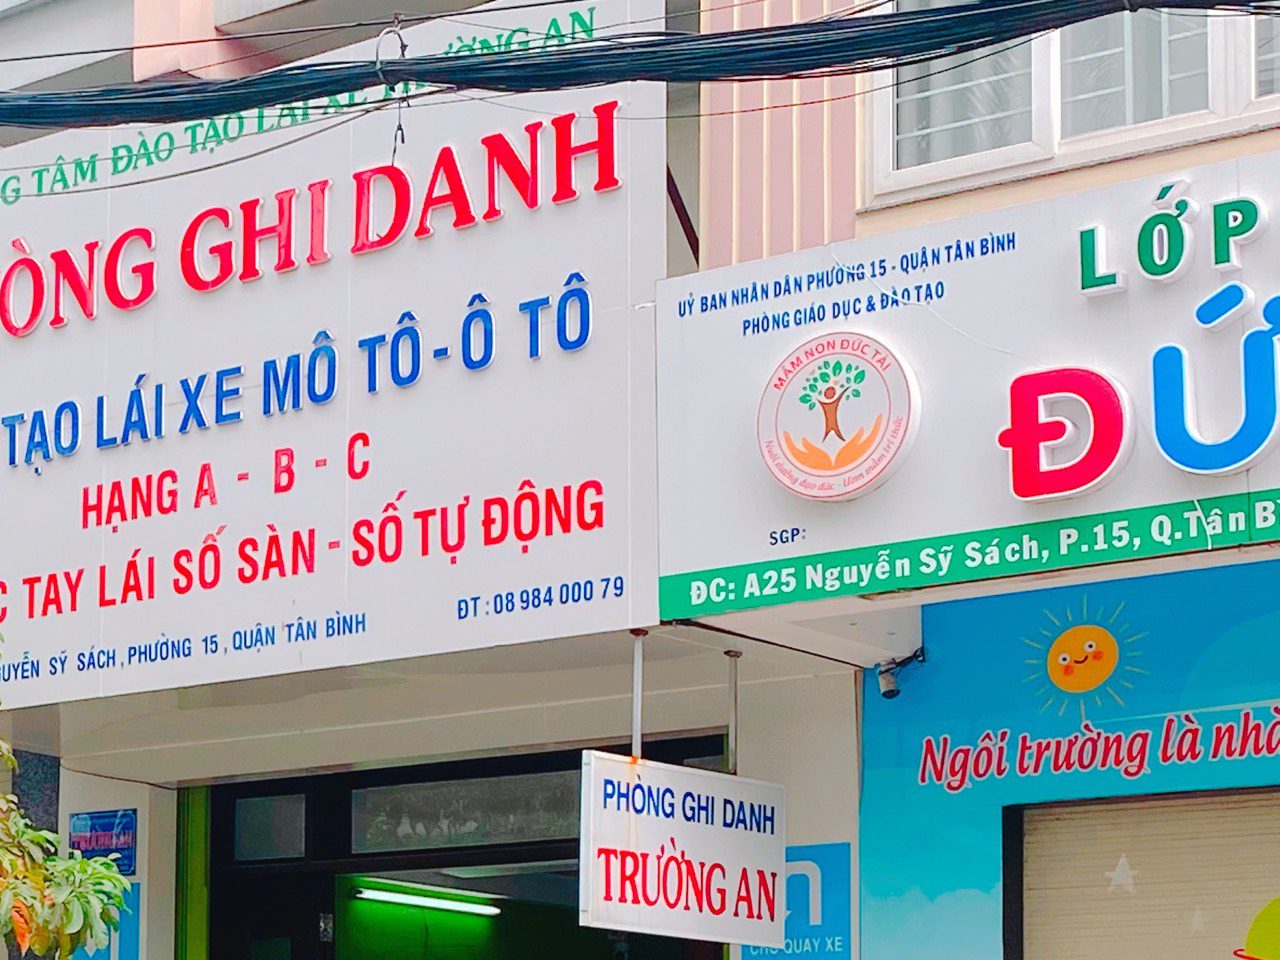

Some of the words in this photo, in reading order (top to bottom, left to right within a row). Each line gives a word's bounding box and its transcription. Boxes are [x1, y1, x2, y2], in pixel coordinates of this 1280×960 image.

[31, 155, 98, 196] TÂM
[111, 131, 175, 175] ĐÀO
[184, 112, 245, 155] TẠO
[179, 178, 333, 292] GHI
[350, 99, 623, 256] DANH
[678, 292, 697, 318] UỶ
[700, 292, 727, 313] BAN
[731, 279, 769, 307] NHÂN
[773, 273, 802, 298] DÂN
[870, 260, 887, 278] 15
[900, 246, 941, 276] QUẬN
[945, 240, 975, 264] TÂN
[980, 232, 1016, 257] BÌNH
[1079, 184, 1259, 289] LỚP
[742, 311, 790, 336] PHÒNG
[793, 302, 826, 324] GIÁO
[832, 298, 861, 321] DỤC
[866, 299, 876, 313] &
[880, 285, 911, 311] ĐÀO
[914, 281, 945, 305] TẠO
[804, 339, 836, 361] NON
[1, 400, 81, 476] TẠO
[96, 374, 164, 448] LÁI
[179, 364, 246, 433] XE
[261, 330, 339, 417] MÔ
[518, 271, 594, 359] TÔ
[81, 470, 179, 535] HẠNG
[193, 463, 218, 508] A
[272, 447, 296, 494] B
[347, 432, 371, 481] C
[22, 568, 85, 619] TAY
[98, 548, 155, 607] LÁI
[172, 524, 227, 594] SỐ
[238, 521, 317, 584] SÀN
[352, 491, 407, 565] SỐ
[412, 494, 469, 565] TỰ
[481, 478, 605, 555] ĐỘNG
[690, 578, 737, 606] ĐC:
[743, 573, 797, 599] A25
[805, 551, 911, 593] Nguyễn
[919, 541, 953, 577] Sỹ
[965, 531, 1049, 569] Sách,
[1059, 521, 1141, 554] P.15,
[1151, 505, 1245, 546] Q.Tân
[1255, 500, 1280, 529] B
[769, 526, 807, 547] SGP:
[521, 585, 554, 612] 984
[558, 580, 593, 607] 000
[600, 576, 625, 602] 79
[49, 650, 68, 676] SỸ
[128, 632, 193, 665] PHƯỜNG
[233, 621, 276, 655] QUẬN
[286, 614, 317, 642] TÂN
[325, 610, 368, 638] BÌNH
[919, 730, 1009, 793] Ngôi
[1017, 722, 1151, 778] trường
[1160, 714, 1201, 763] là
[603, 774, 676, 819] PHÒNG
[681, 794, 715, 828] GHI
[723, 799, 775, 835] DANH
[597, 837, 727, 917] TRƯỜNG
[732, 869, 778, 923] AN
[784, 937, 820, 954] QUAY
[825, 936, 843, 952] XE
